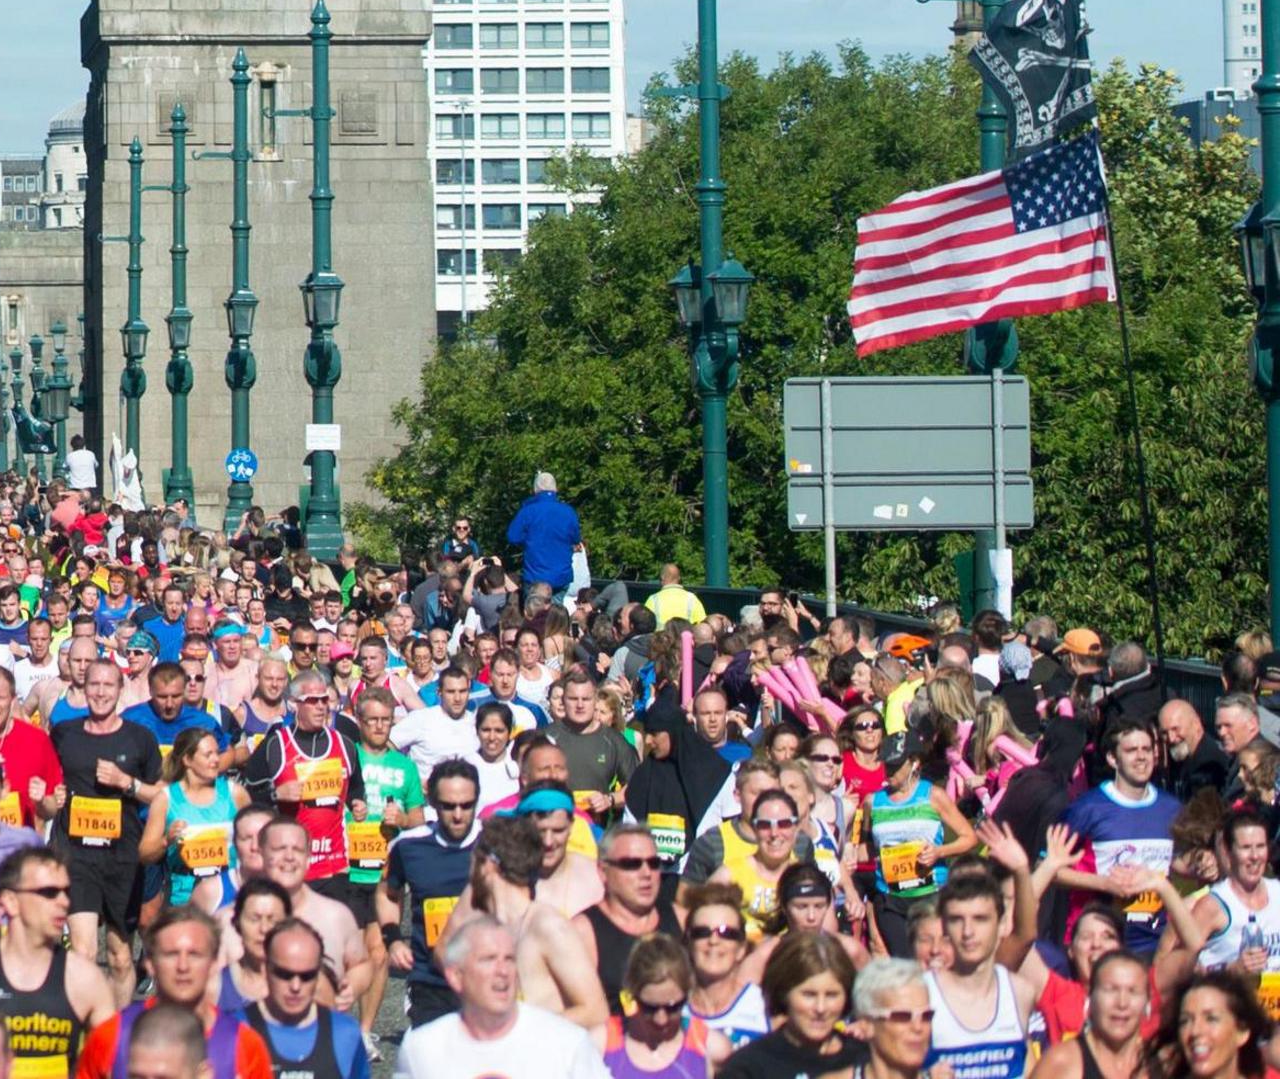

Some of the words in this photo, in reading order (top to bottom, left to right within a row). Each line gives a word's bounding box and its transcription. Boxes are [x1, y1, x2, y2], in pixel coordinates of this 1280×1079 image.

[77, 817, 117, 830] 11846
[186, 846, 223, 861] 13564
[10, 1034, 68, 1053] nners
